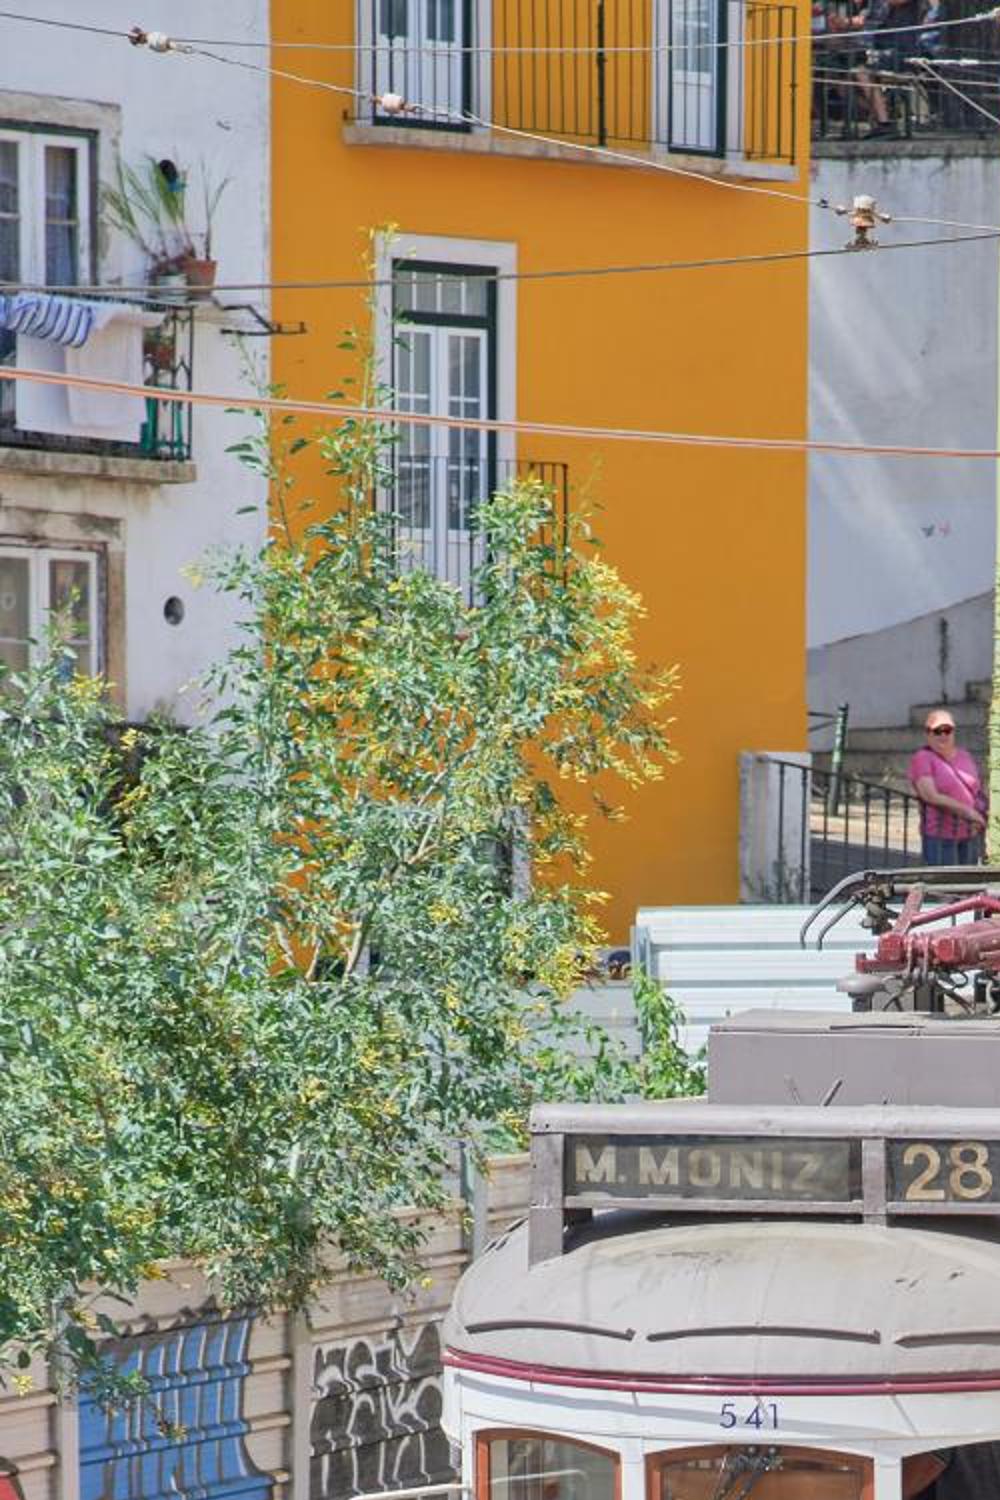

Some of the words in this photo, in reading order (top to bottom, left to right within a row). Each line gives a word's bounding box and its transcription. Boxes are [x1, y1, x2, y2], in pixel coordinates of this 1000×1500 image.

[575, 1144, 628, 1184] M.
[638, 1147, 825, 1191] MONIZ
[903, 1141, 994, 1200] 28
[720, 1403, 778, 1430] 541
